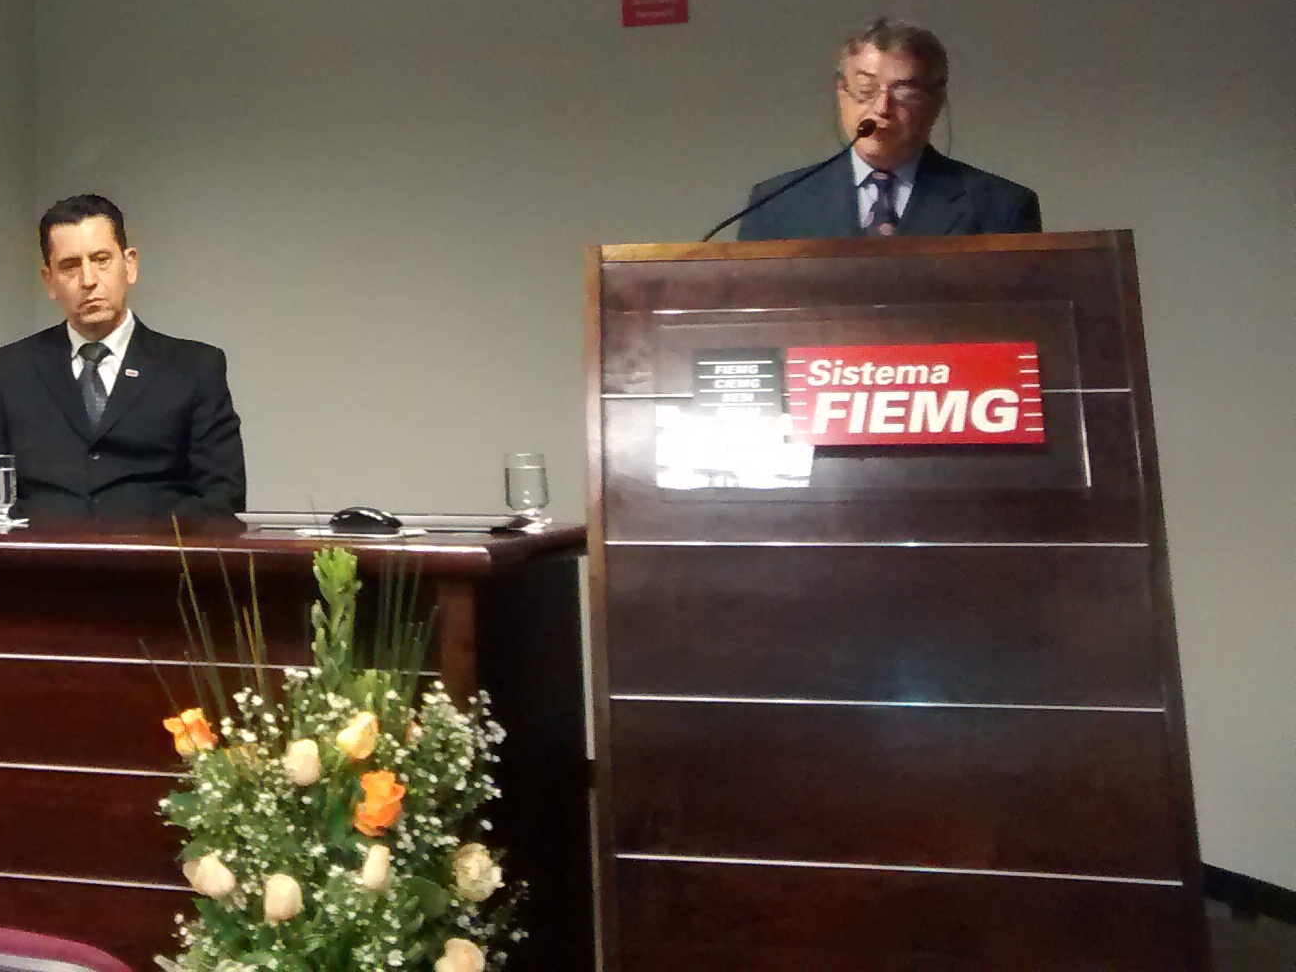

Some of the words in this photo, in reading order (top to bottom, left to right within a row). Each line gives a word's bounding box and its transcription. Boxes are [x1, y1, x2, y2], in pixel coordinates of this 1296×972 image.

[714, 364, 760, 375] FIEMG
[808, 359, 950, 387] Sistema
[714, 378, 761, 389] CIEMG
[812, 388, 1020, 434] FIEMG
